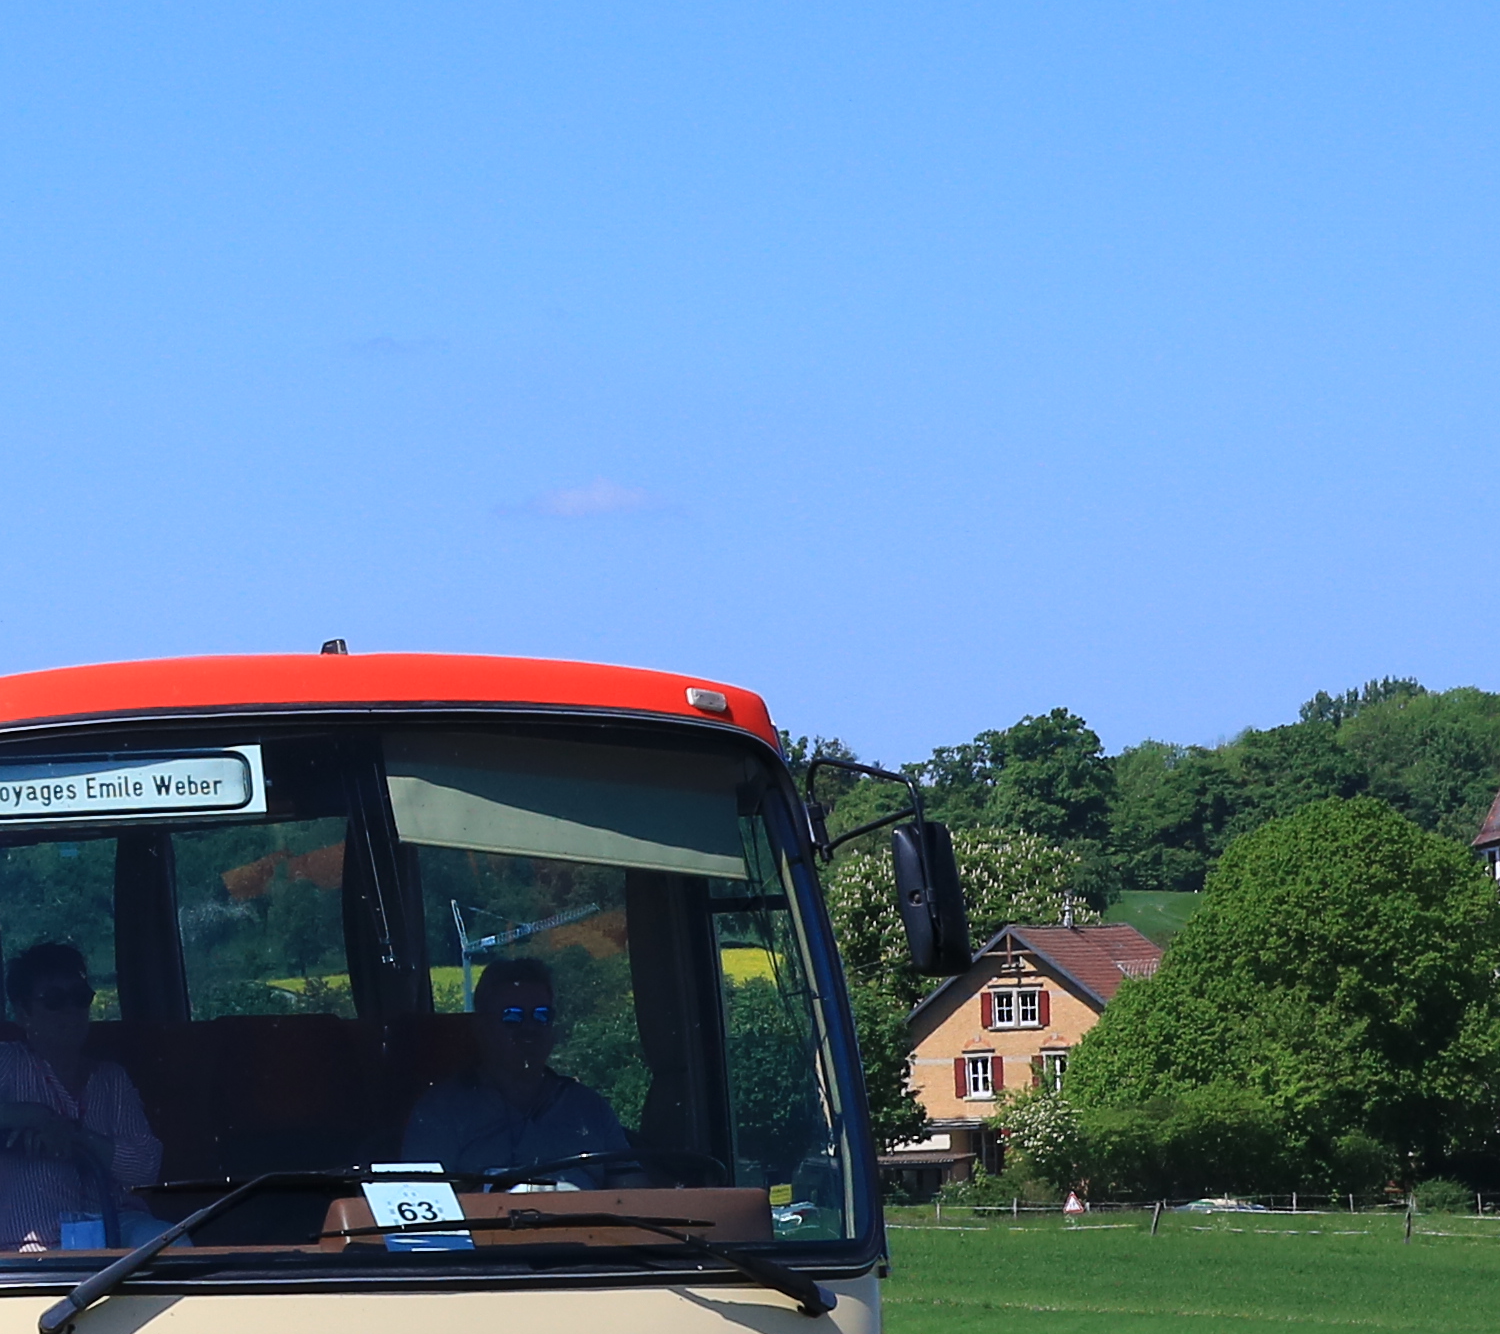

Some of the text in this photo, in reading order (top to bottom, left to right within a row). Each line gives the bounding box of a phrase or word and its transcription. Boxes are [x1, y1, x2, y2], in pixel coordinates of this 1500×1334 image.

[86, 777, 144, 800] Emile
[152, 773, 224, 797] Weber
[397, 1201, 438, 1222] 63
